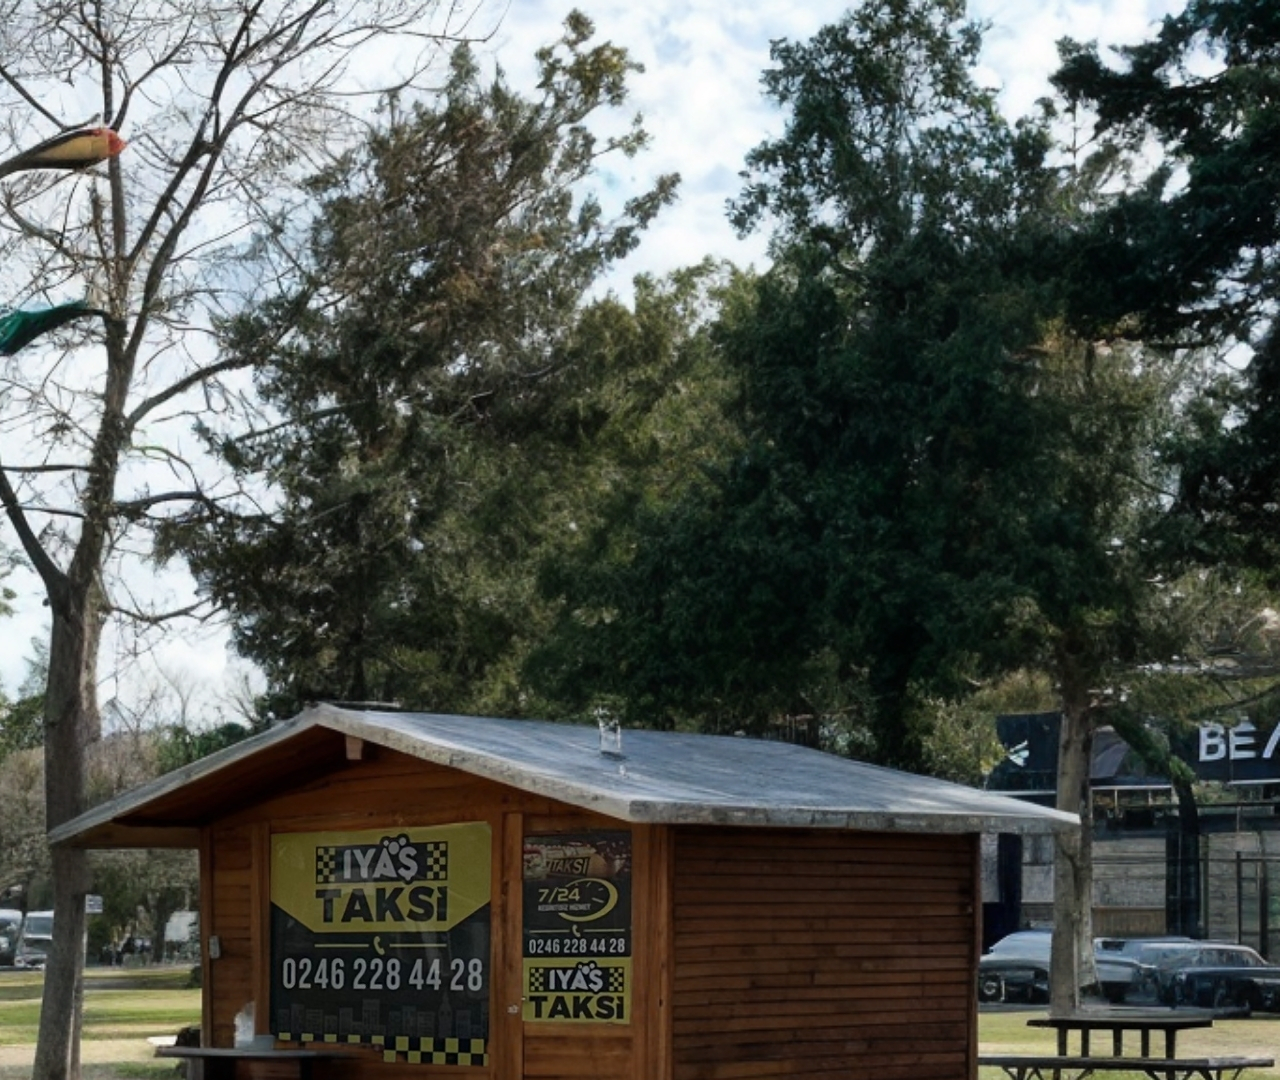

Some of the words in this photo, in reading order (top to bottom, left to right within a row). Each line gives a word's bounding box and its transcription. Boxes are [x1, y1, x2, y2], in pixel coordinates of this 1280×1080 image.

[538, 887, 580, 903] 7/24
[529, 939, 560, 954] 0246
[563, 939, 587, 953] 228
[590, 938, 606, 953] 44
[609, 938, 625, 953] 28
[283, 958, 345, 989] 0246
[353, 958, 401, 990] 228
[408, 958, 442, 991] 44
[450, 958, 483, 991] 28
